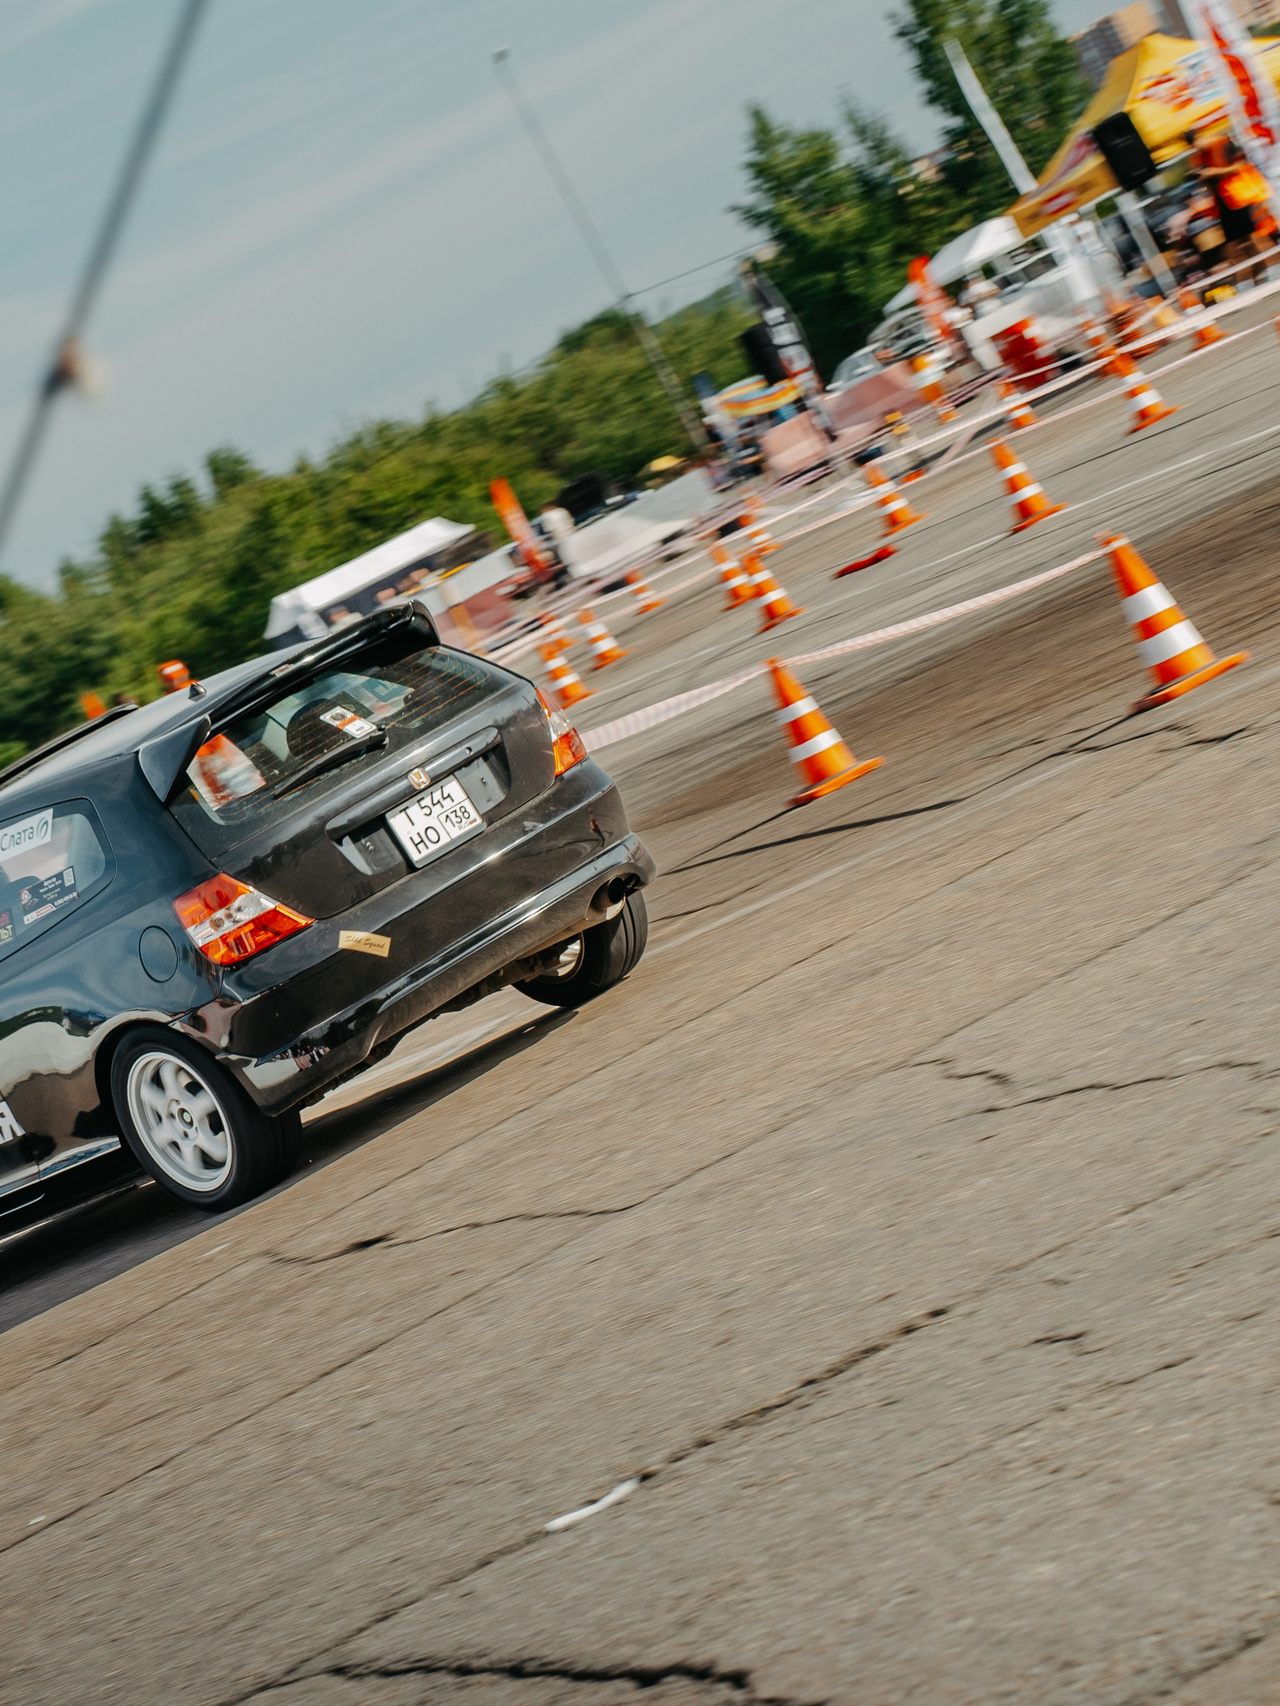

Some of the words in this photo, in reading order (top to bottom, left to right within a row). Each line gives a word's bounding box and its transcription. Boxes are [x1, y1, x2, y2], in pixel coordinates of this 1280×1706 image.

[417, 785, 454, 817] 544
[0, 825, 35, 852] Слата
[409, 826, 441, 854] НО
[444, 805, 471, 828] 138
